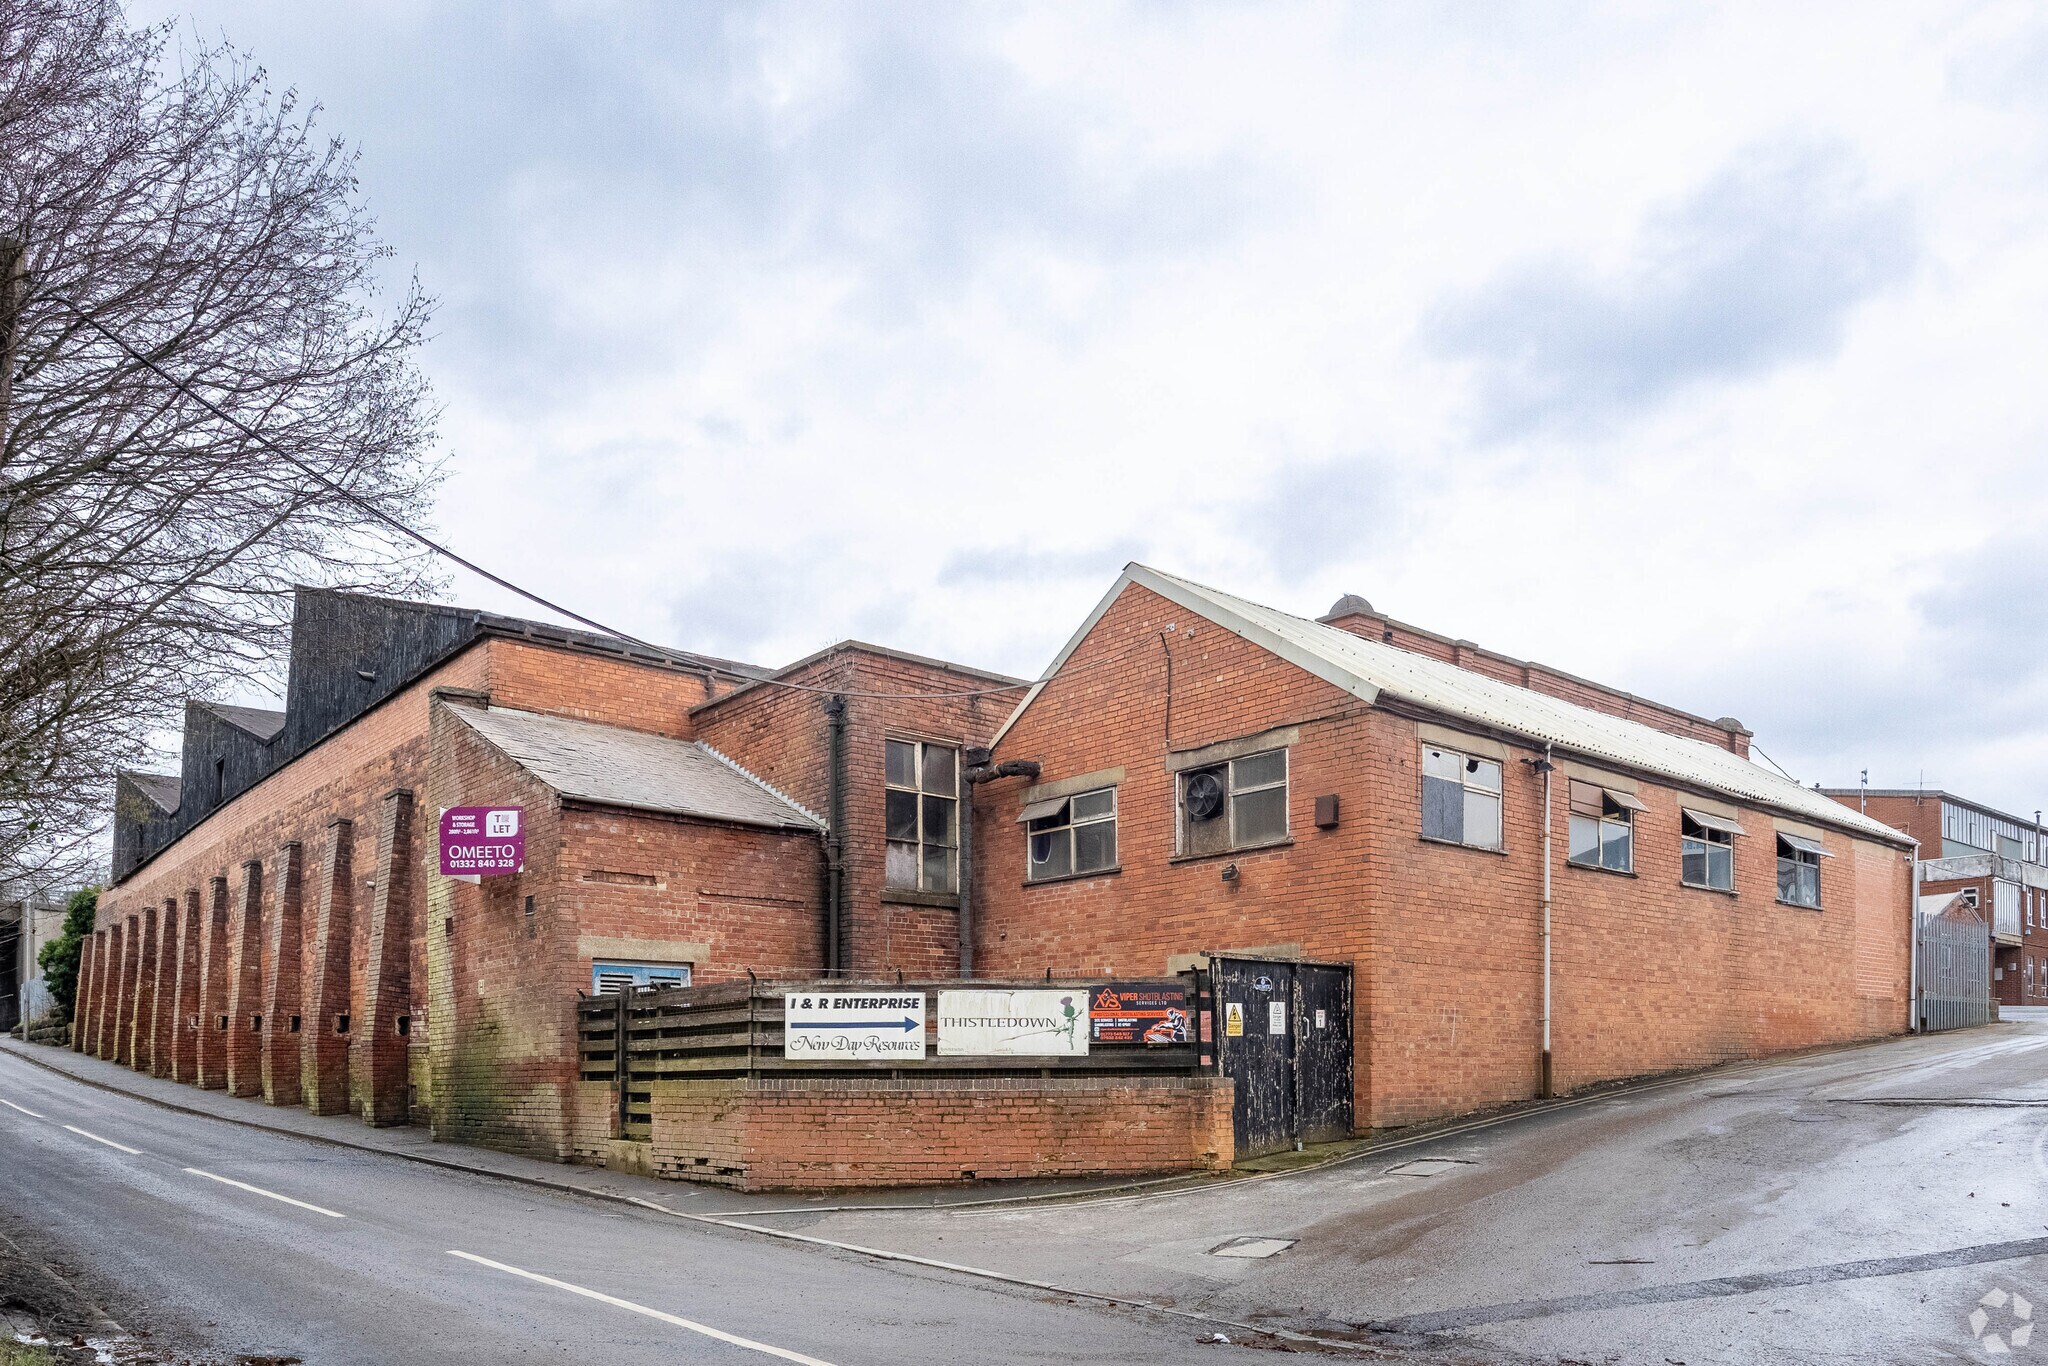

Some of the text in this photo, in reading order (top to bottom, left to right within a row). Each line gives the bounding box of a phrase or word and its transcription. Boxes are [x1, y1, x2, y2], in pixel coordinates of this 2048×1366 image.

[493, 824, 511, 834] LET
[448, 844, 516, 859] OMEETO
[450, 859, 514, 868] 01332 840 328
[1120, 992, 1184, 1001] VIPER SHOTBLASTING
[790, 997, 920, 1010] I & R ENTERPRISE
[940, 1017, 1057, 1028] THISTLEDOWN
[790, 1035, 920, 1056] New Day Resources
